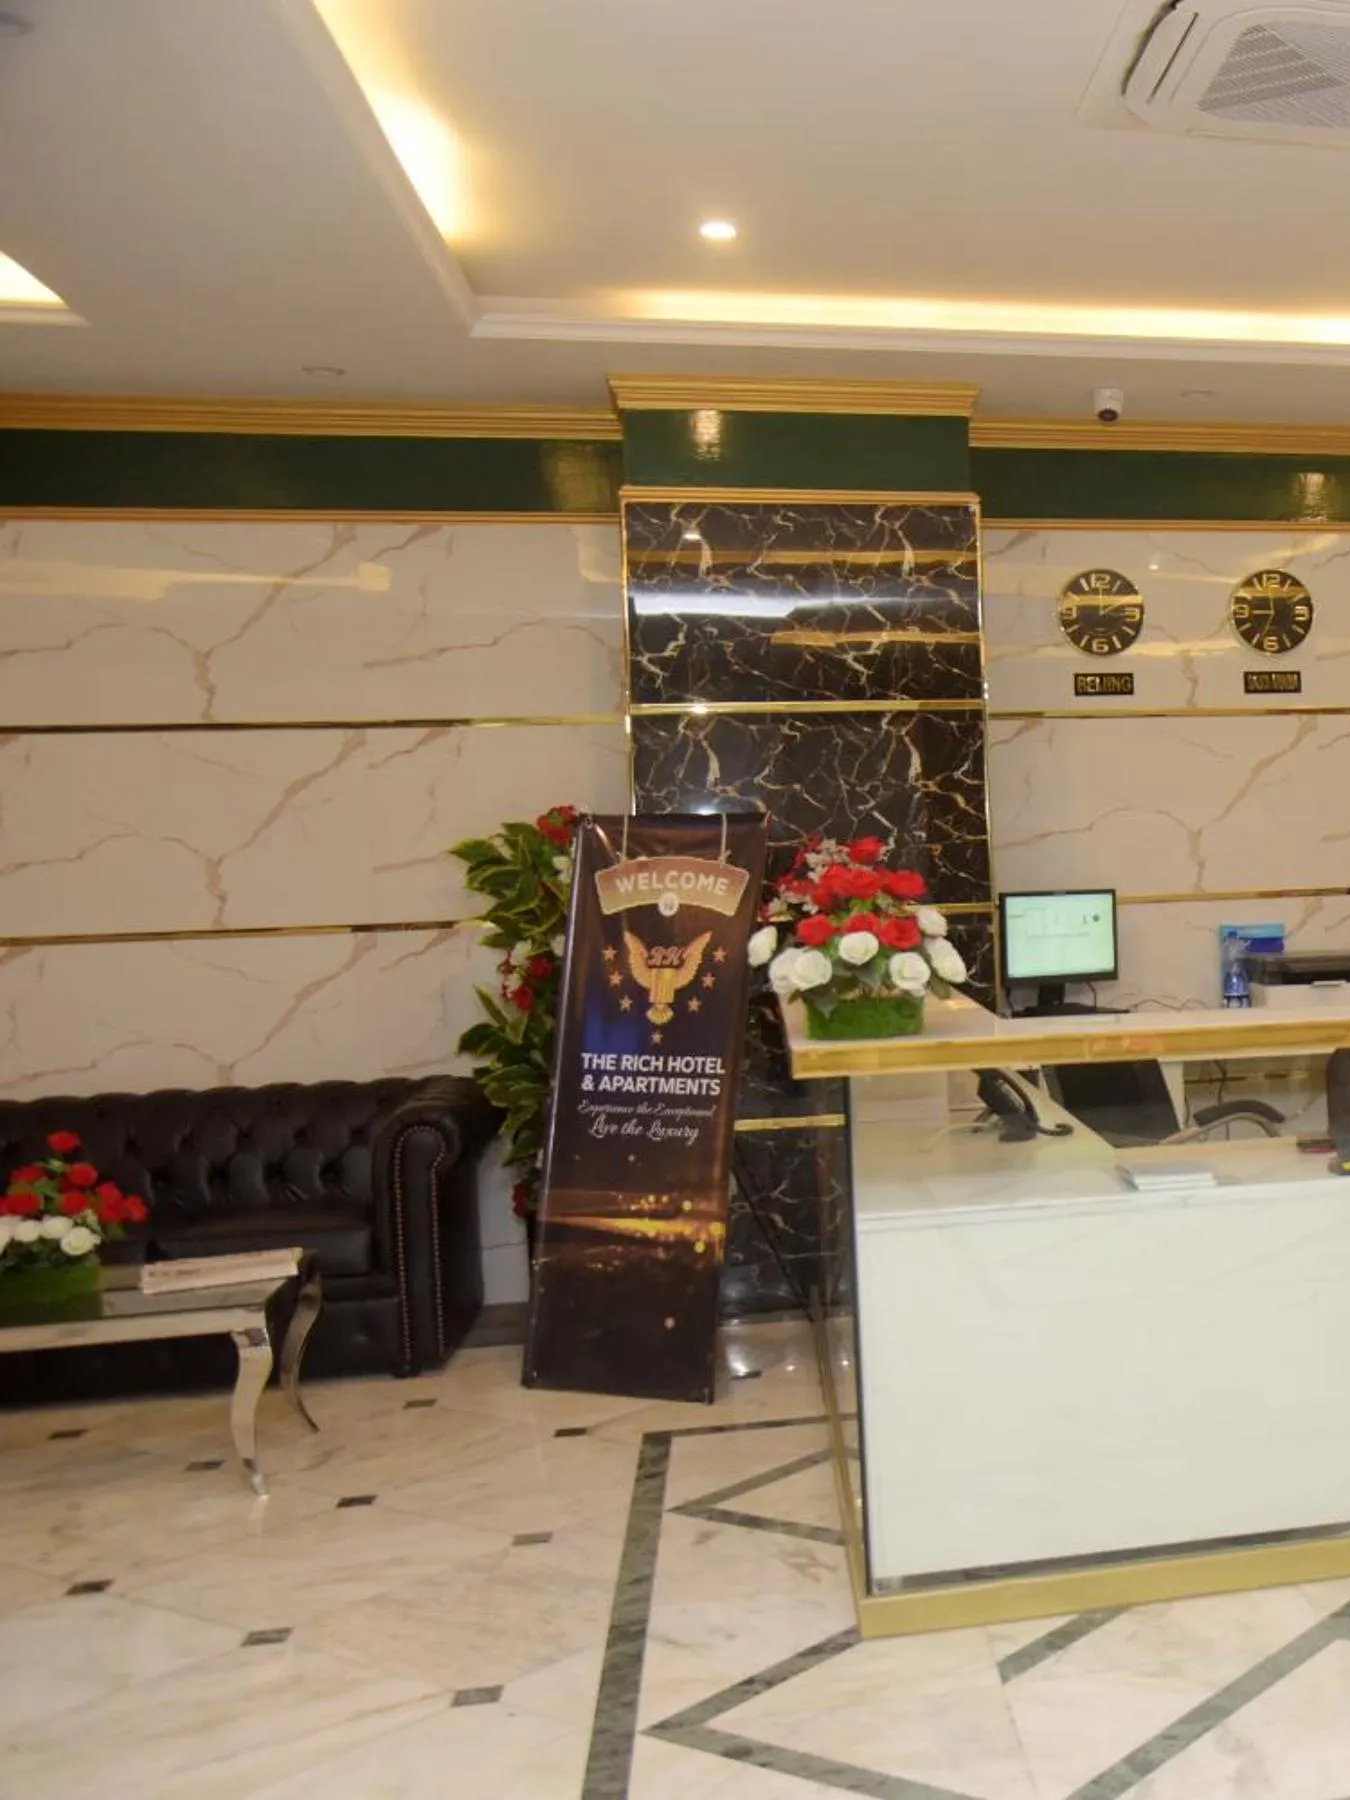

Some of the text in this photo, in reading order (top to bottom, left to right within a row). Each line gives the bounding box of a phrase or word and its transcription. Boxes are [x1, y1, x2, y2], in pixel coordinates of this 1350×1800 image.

[1091, 573, 1111, 588] 12
[1263, 574, 1280, 587] 12
[1063, 606, 1077, 619] 9
[1125, 607, 1140, 621] 3
[1235, 605, 1249, 618] 9
[1294, 605, 1308, 618] 3
[1092, 639, 1109, 653] 6
[1263, 637, 1278, 651] 6
[1077, 676, 1131, 692] BEIJING
[615, 871, 729, 896] WELCOME
[581, 1053, 725, 1075] THE RICH HOTEL
[581, 1074, 721, 1096] & APARTMENTS
[588, 1113, 700, 1146] Live the Luxury
